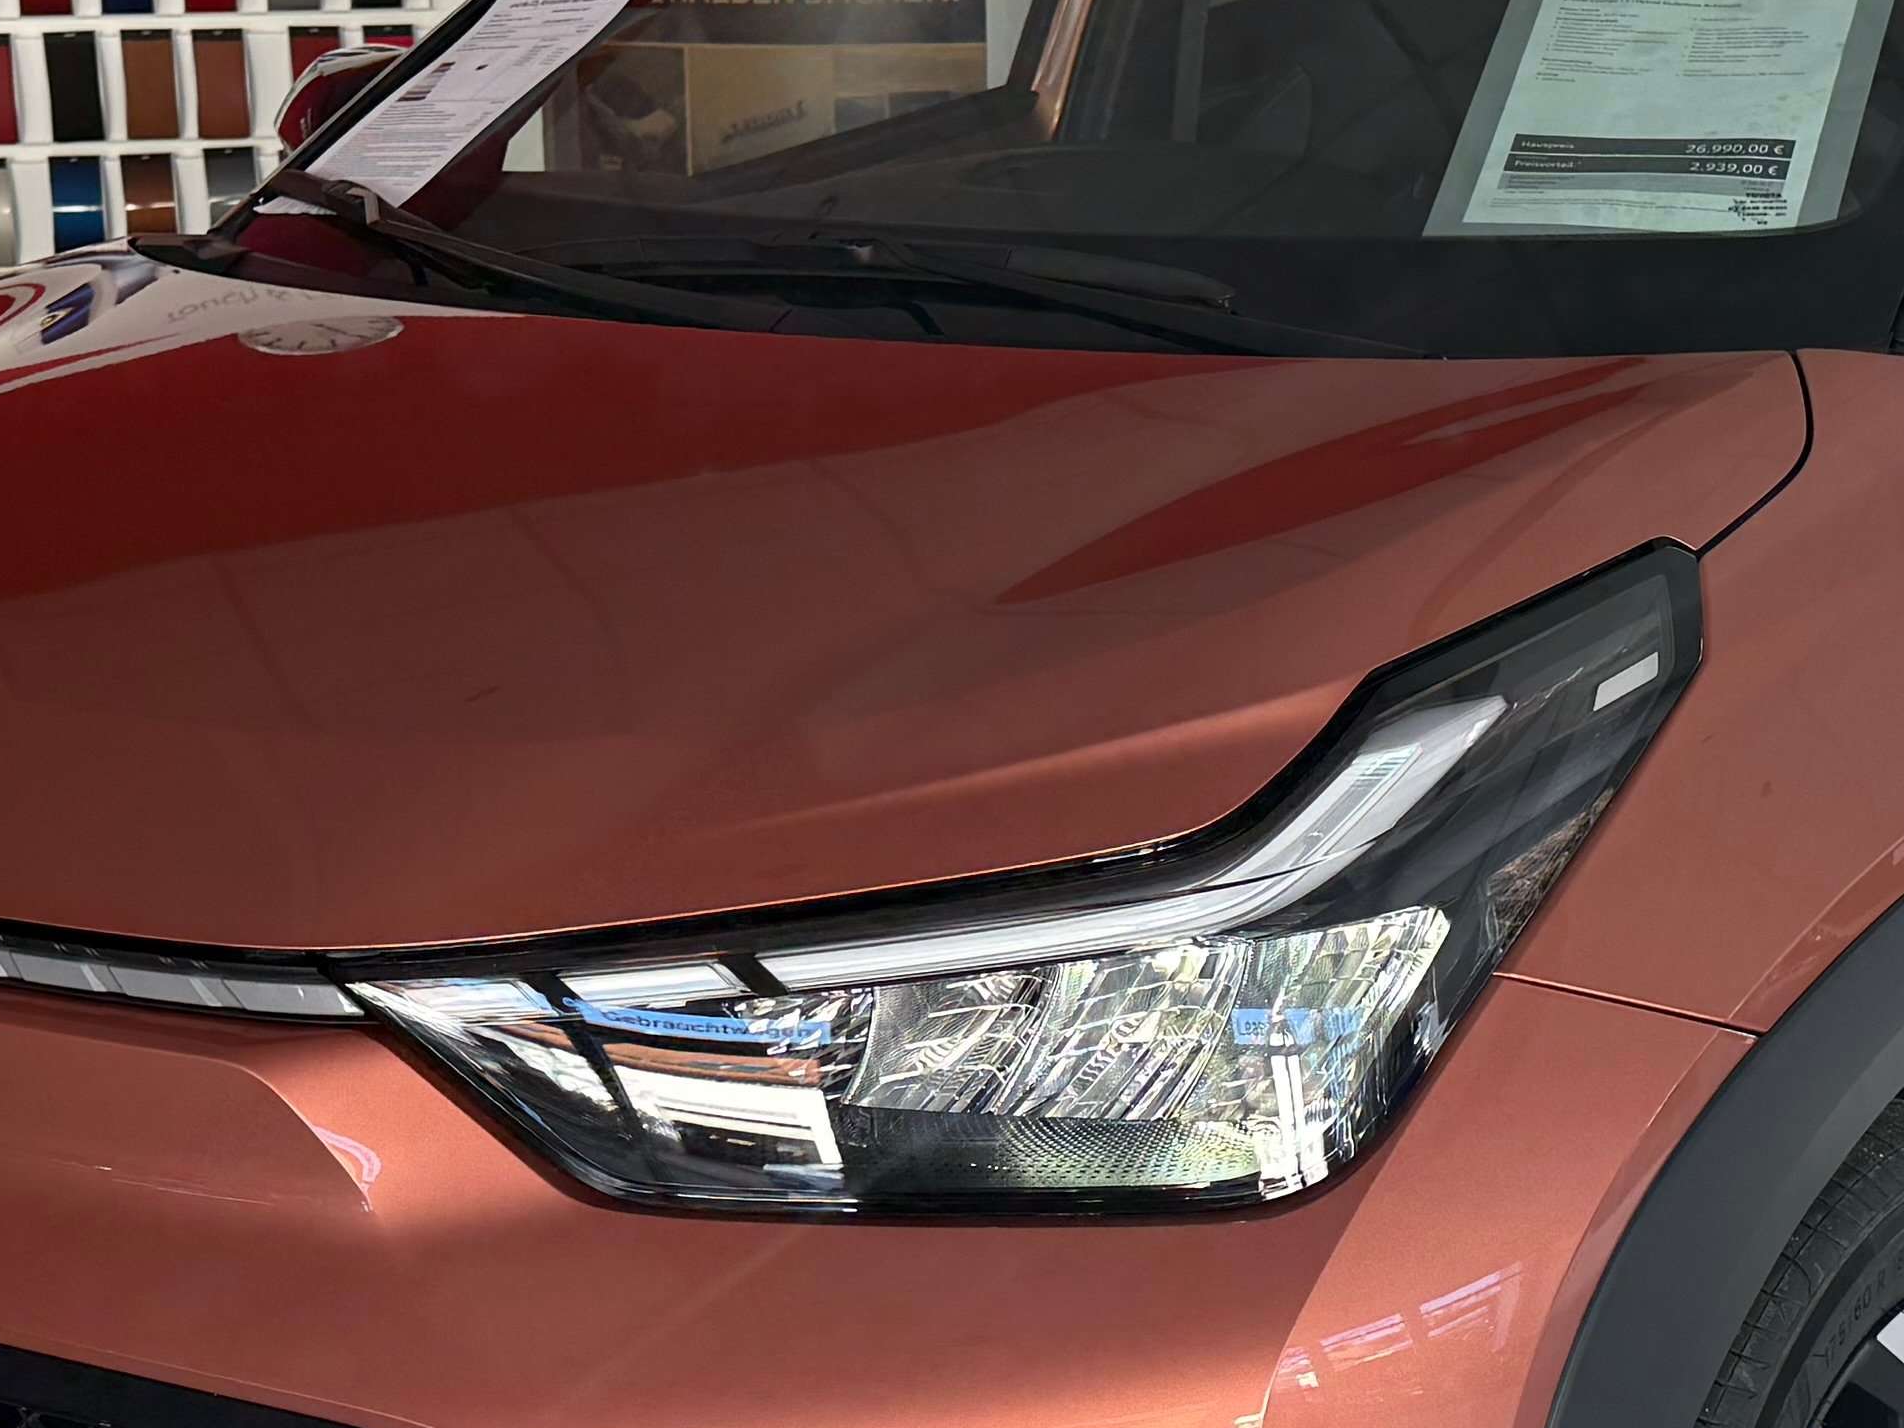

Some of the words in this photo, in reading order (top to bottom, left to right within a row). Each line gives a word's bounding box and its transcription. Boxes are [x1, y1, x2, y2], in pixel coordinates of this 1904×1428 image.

[1684, 143, 1770, 156] 26.990,00
[1773, 144, 1786, 156] €
[1688, 162, 1764, 176] 2.939,00
[1767, 165, 1780, 176] €
